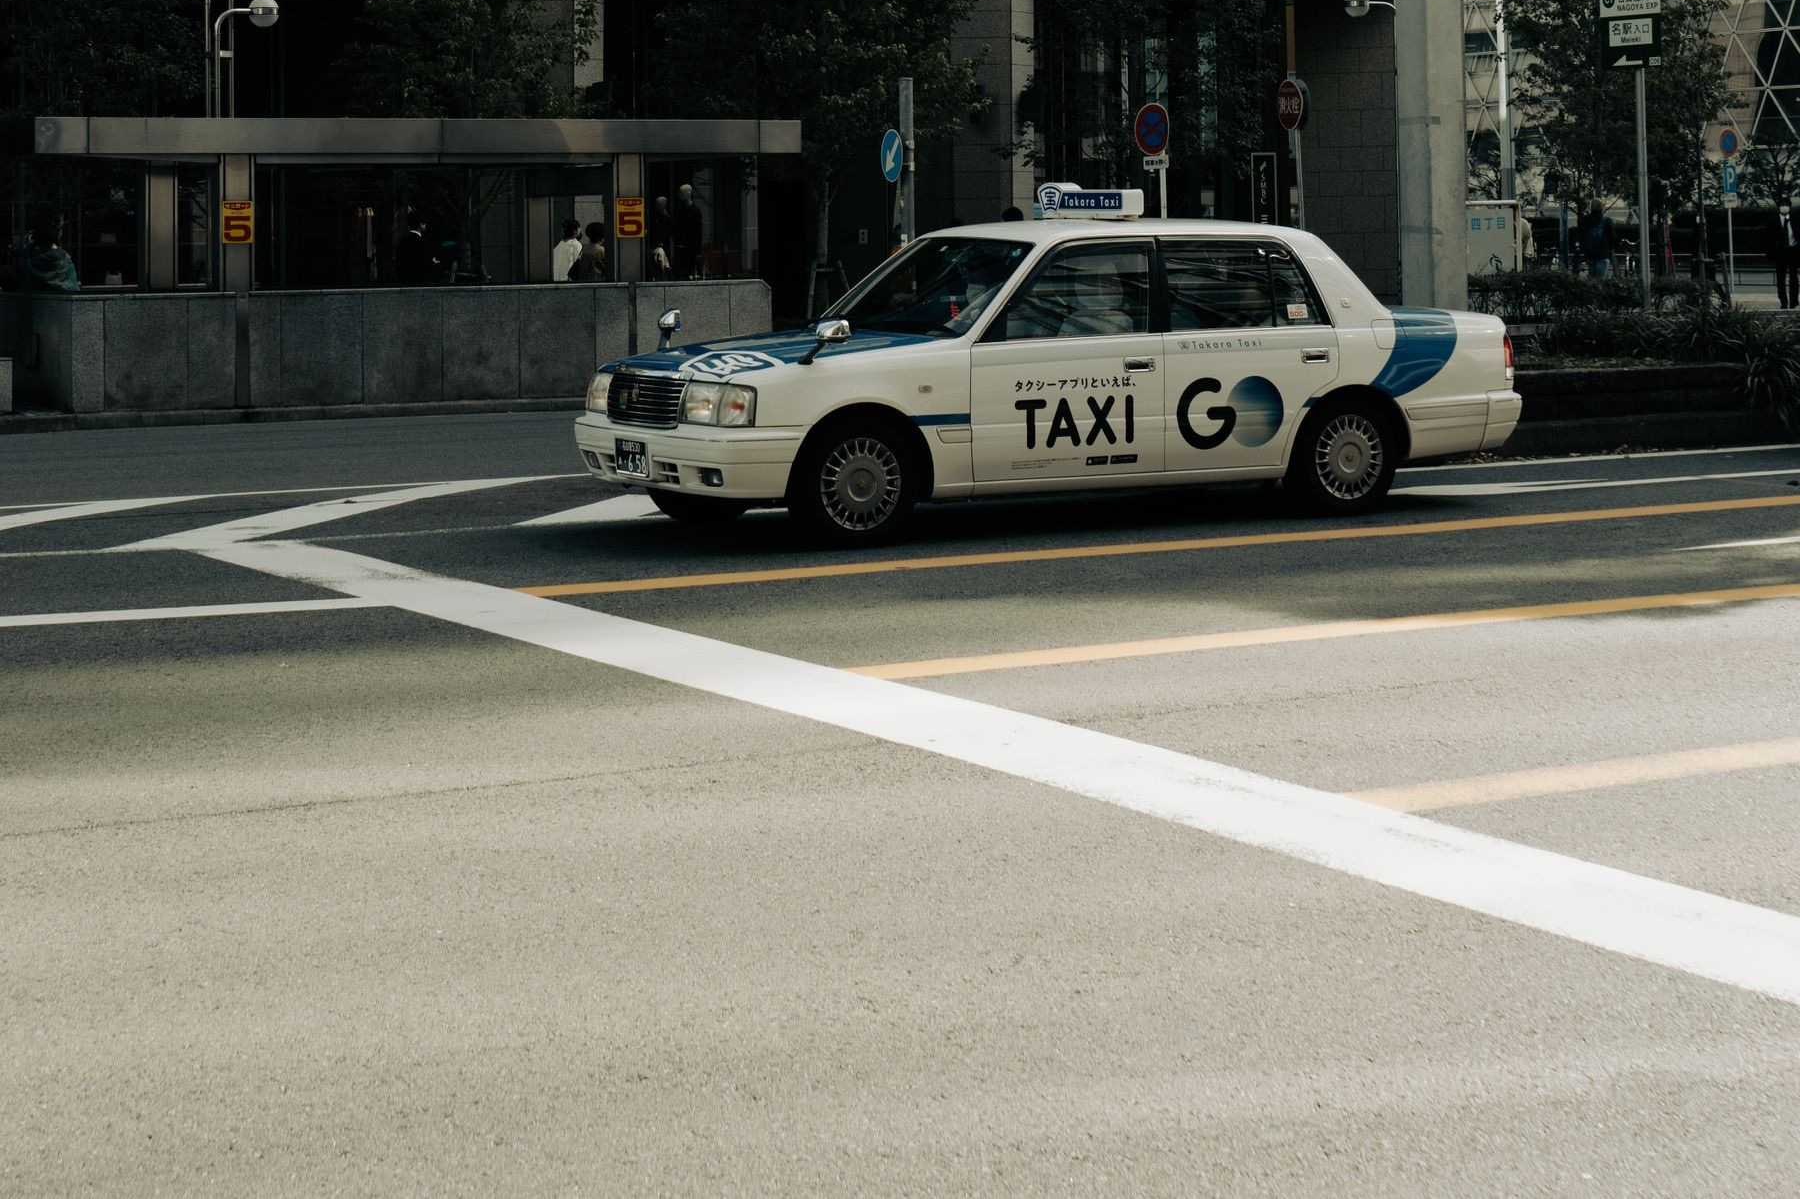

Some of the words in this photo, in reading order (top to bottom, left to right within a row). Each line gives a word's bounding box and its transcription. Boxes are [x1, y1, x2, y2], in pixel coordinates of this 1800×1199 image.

[1617, 3, 1644, 12] NAGOYA
[1646, 1, 1659, 9] EXP
[1612, 23, 1650, 36] 名駅入口
[1278, 96, 1299, 114] 消火栓
[1727, 167, 1735, 191] P
[1260, 173, 1268, 204] SMBC
[1064, 196, 1096, 207] Takara
[1100, 196, 1119, 207] Taxi
[224, 216, 251, 241] 5
[618, 211, 643, 236] 5
[1465, 216, 1505, 231] 四丁目
[1192, 341, 1232, 349] Takara
[1237, 338, 1262, 347] Taxi
[1015, 375, 1136, 393] タクシーアプリといえば、
[1014, 394, 1134, 450] TAXI
[1176, 376, 1284, 450] GO
